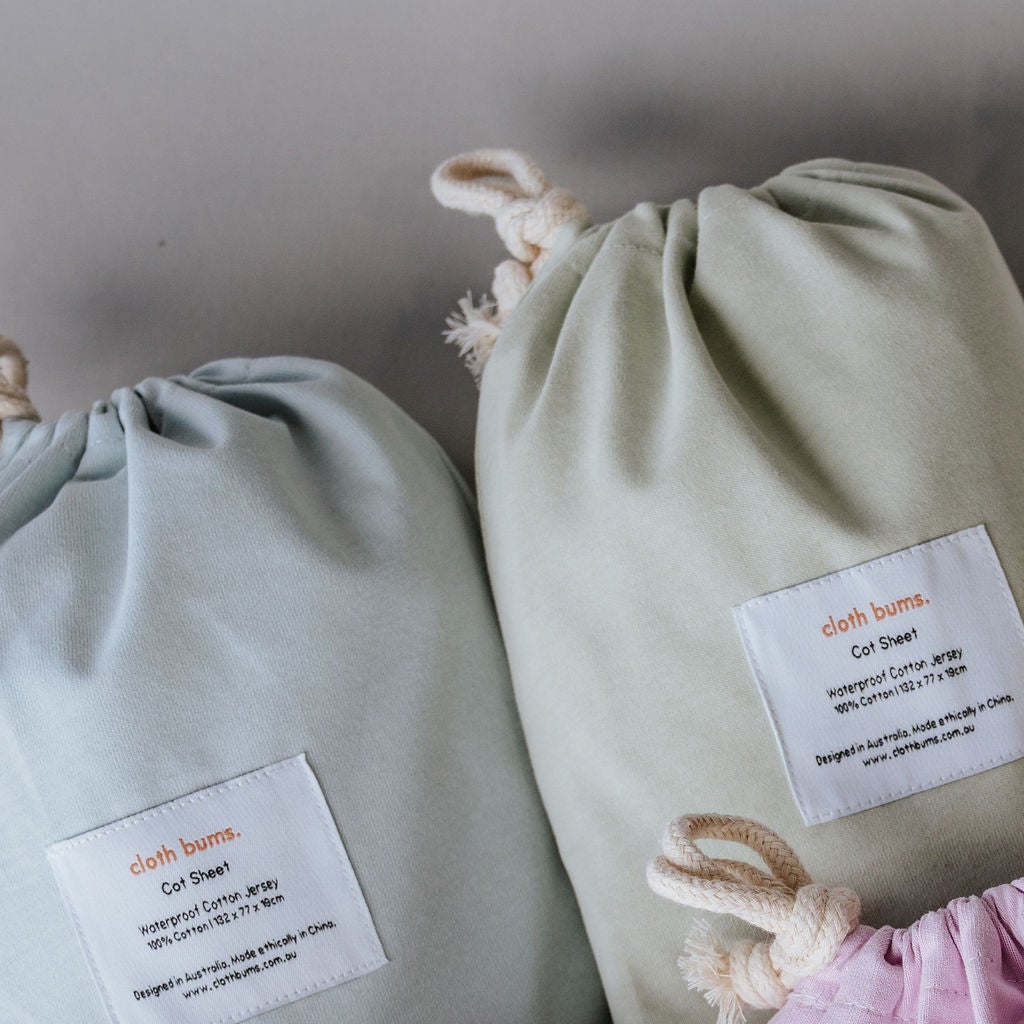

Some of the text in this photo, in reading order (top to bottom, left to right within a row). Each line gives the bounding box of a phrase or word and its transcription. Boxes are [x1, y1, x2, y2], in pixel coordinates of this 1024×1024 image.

[821, 593, 930, 637] cloth bums.
[850, 627, 918, 659] Cot Sheet
[826, 648, 962, 699] Waterproof Cotton Jersey
[833, 700, 859, 714] 100%
[859, 689, 894, 707] Cotton
[898, 679, 916, 693] 132
[916, 679, 923, 689] x
[922, 672, 934, 685] 77
[936, 673, 944, 682] x
[944, 664, 968, 678] 19cm
[815, 694, 1014, 766] Designed in Australia. Made ethically in China.
[129, 827, 241, 875] cloth bums.
[161, 860, 230, 896] Cot Sheet
[138, 878, 278, 936] Waterproof Cotton Jersey
[147, 935, 173, 950] 100%
[173, 923, 209, 942] Cotton
[212, 912, 231, 926] 132
[231, 911, 239, 920] x
[238, 904, 250, 916] 77
[252, 903, 260, 912] x
[259, 894, 285, 908] 19cm
[132, 920, 337, 1001] Designed in Australia. Made ethically in China.
